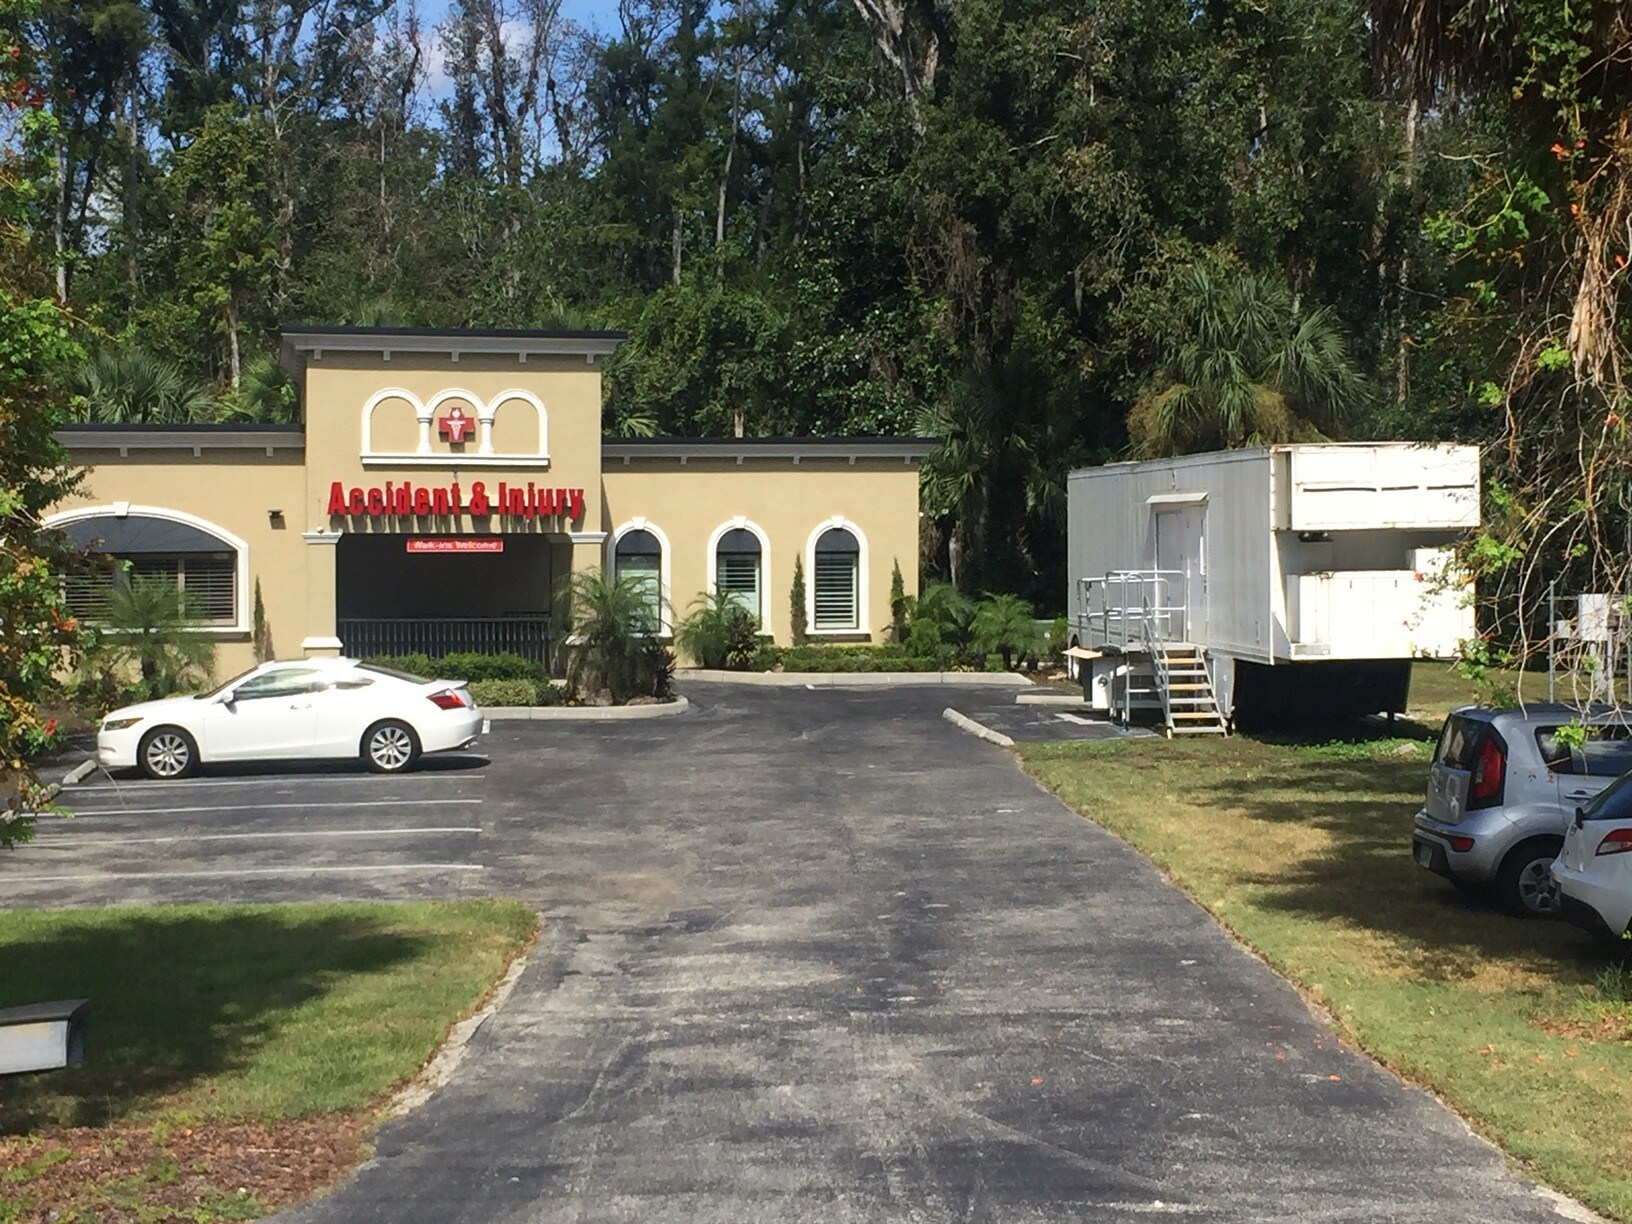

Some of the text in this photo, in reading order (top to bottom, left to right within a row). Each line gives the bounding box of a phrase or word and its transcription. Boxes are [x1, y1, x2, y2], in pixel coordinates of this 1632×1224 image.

[328, 481, 585, 519] Accident & Injury
[455, 541, 497, 550] Welcome
